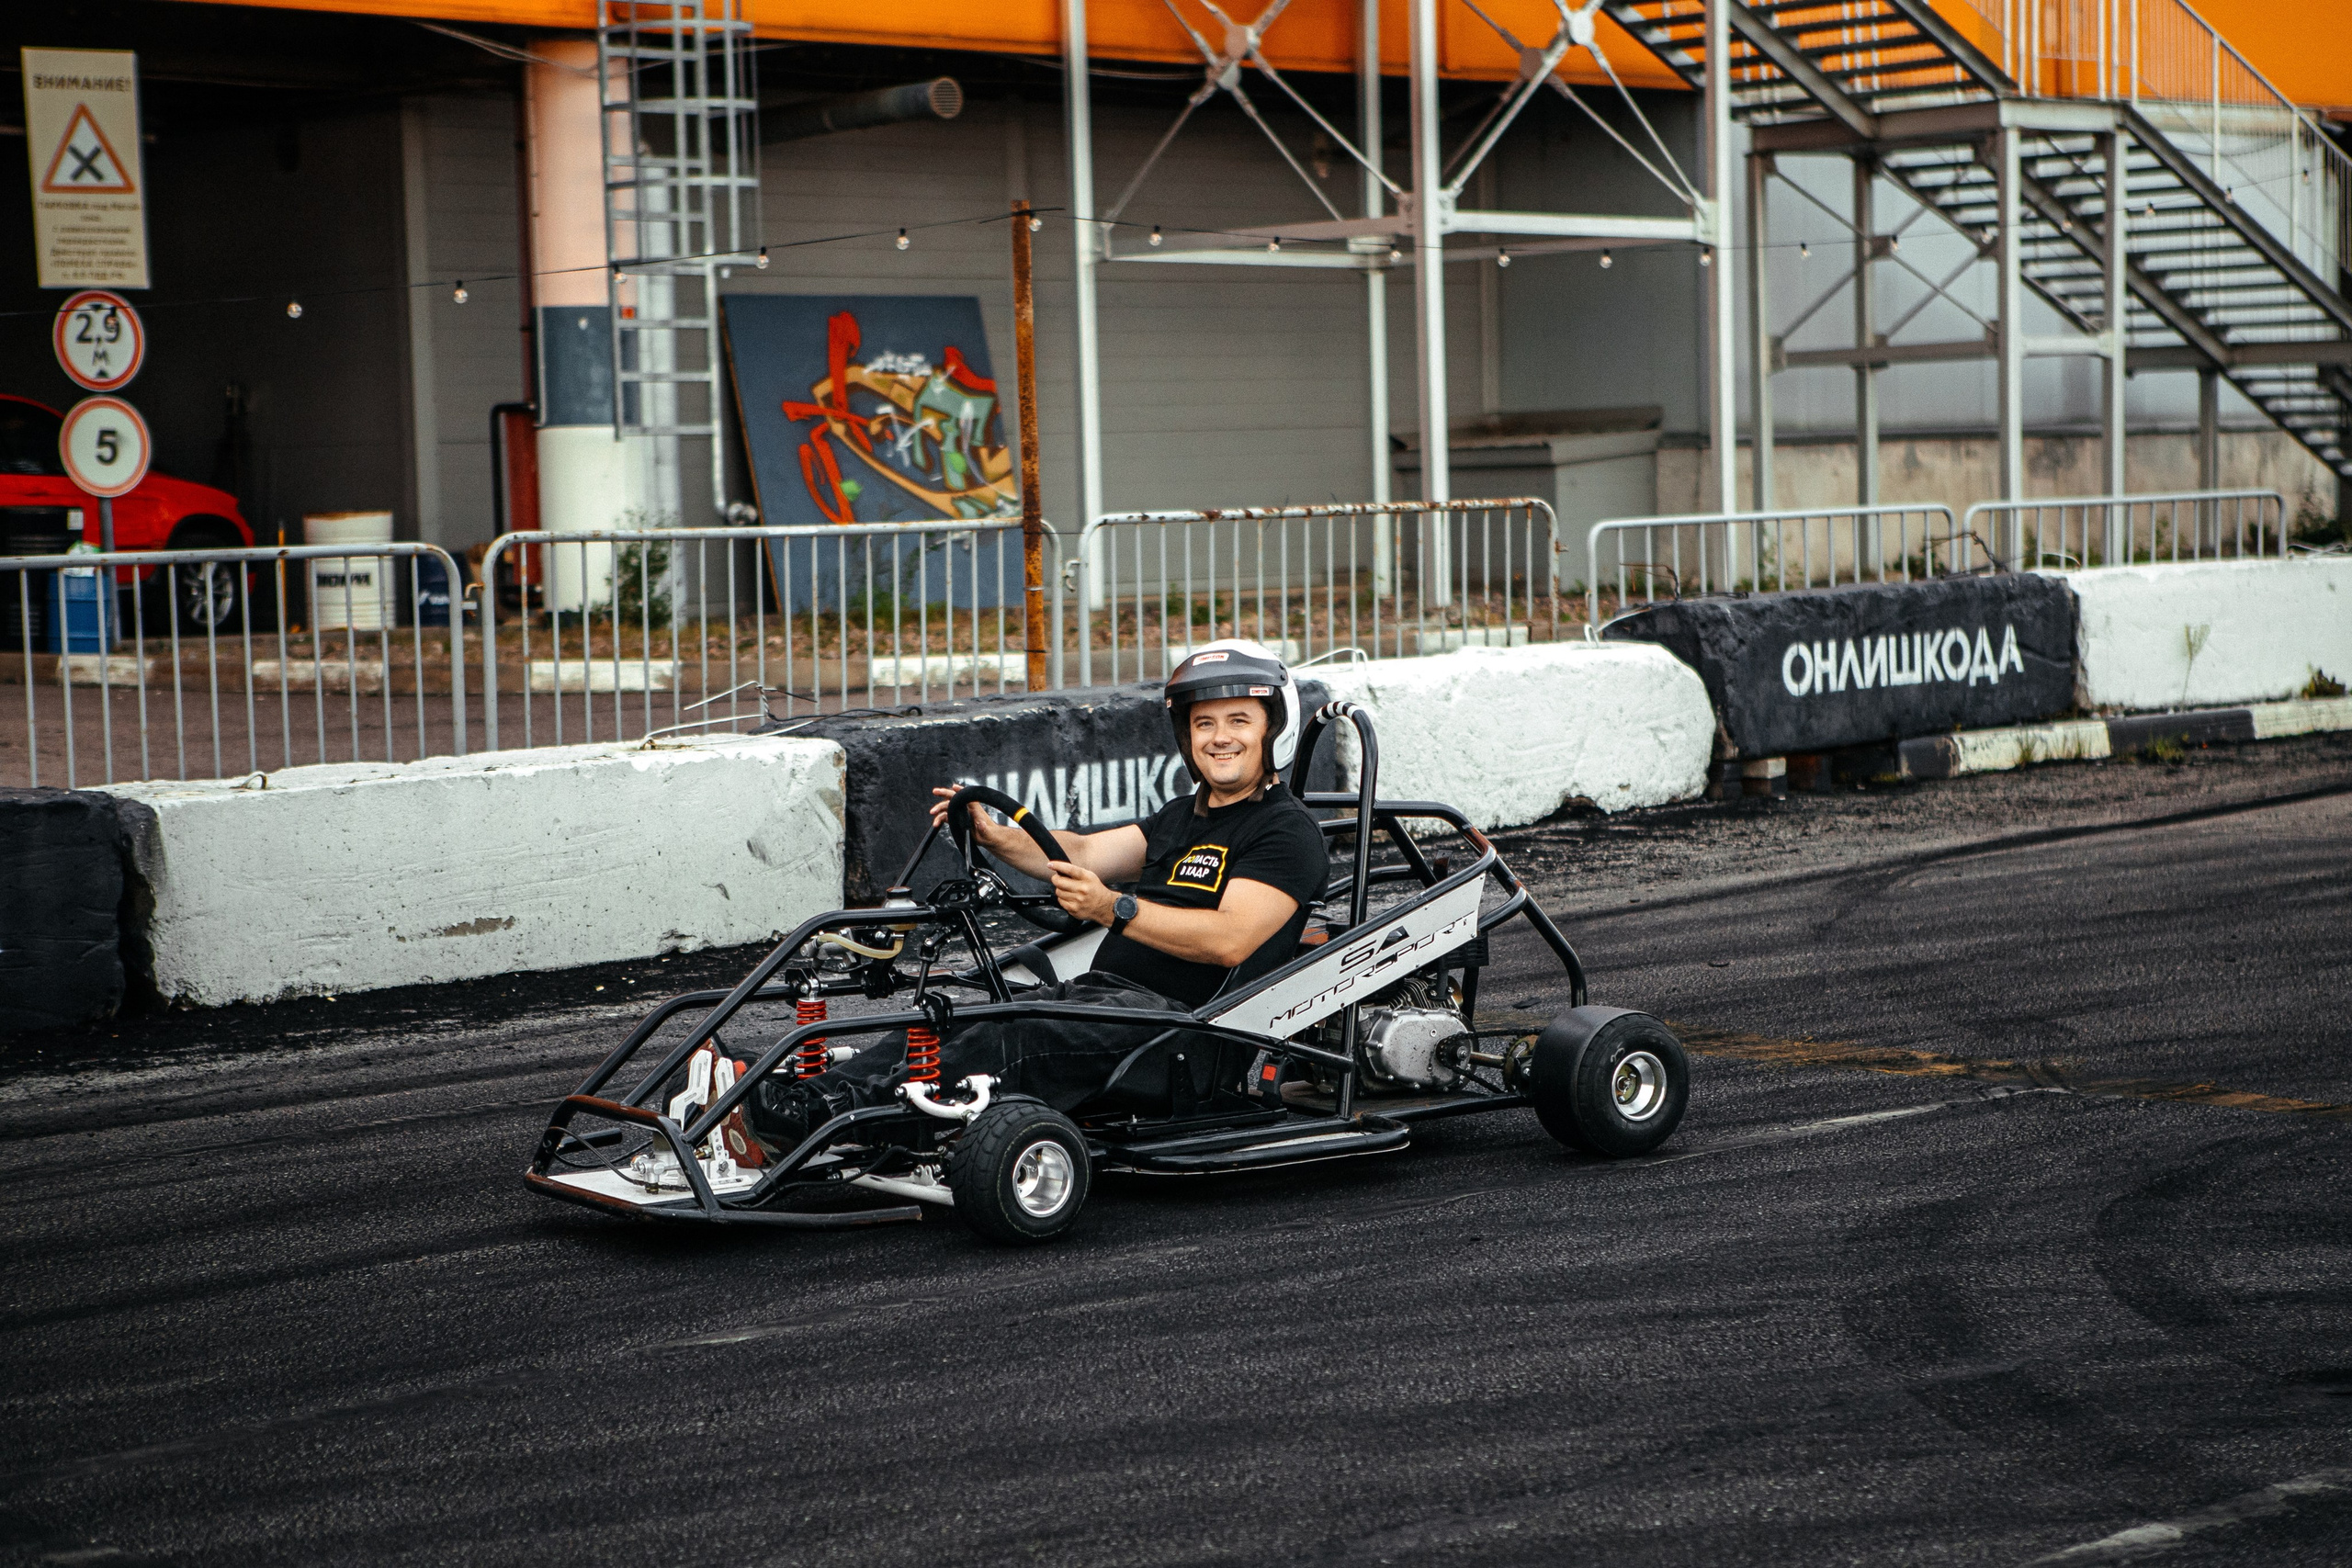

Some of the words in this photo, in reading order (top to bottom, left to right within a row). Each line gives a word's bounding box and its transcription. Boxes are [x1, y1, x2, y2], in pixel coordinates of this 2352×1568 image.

[96, 429, 119, 466] 5
[1781, 623, 2025, 696] ОНЛИШКОДА
[1185, 866, 1210, 879] КАДР
[1269, 909, 1476, 1029] MOTORSPORT
